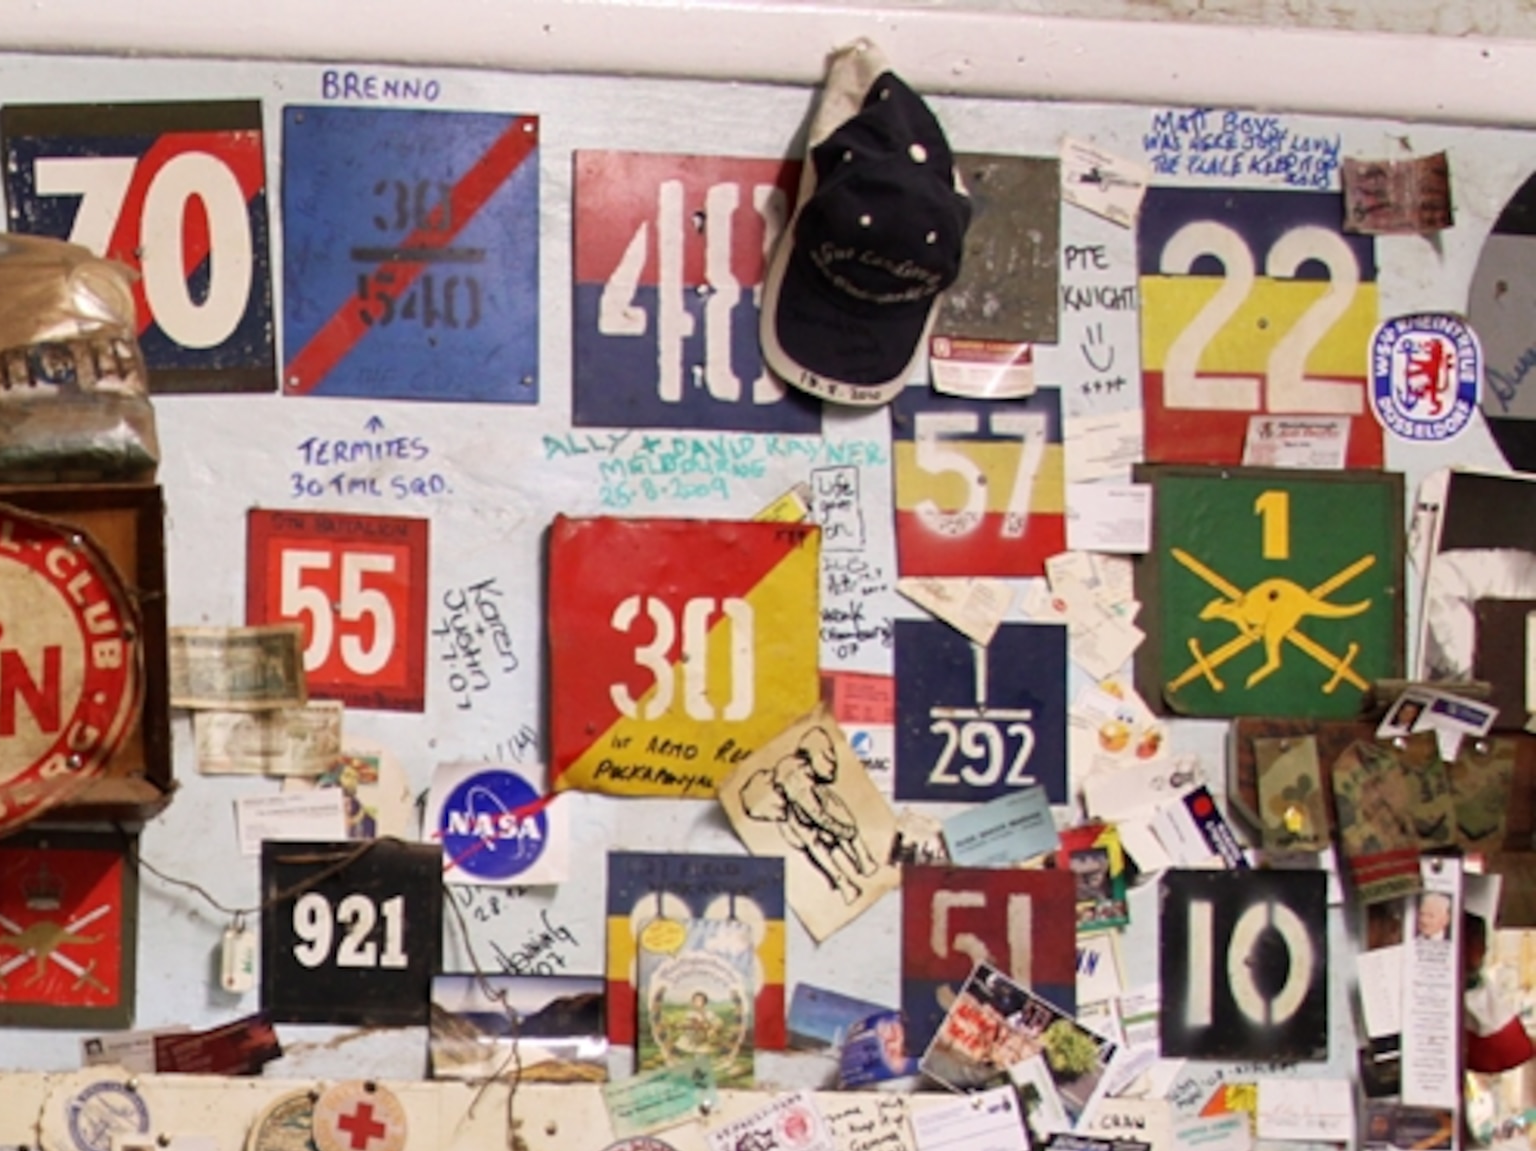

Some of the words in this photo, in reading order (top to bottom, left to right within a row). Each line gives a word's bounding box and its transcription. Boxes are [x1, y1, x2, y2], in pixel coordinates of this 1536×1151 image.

[321, 70, 441, 102] BRENNO
[33, 150, 253, 350] 70
[1064, 246, 1110, 271] PTE
[1062, 286, 1135, 312] KNIGHT
[1159, 219, 1363, 415] 22
[297, 435, 431, 466] TERMITES
[541, 428, 632, 460] ALLY
[671, 434, 756, 460] DAVID
[914, 411, 1047, 539] 57
[1254, 490, 1290, 560] 1
[280, 548, 396, 676] 55
[468, 576, 520, 674] Karen
[609, 594, 756, 722] 30
[928, 719, 1037, 787] 292
[447, 810, 541, 841] NASA
[292, 892, 409, 968] 921
[1185, 900, 1314, 1028] 10
